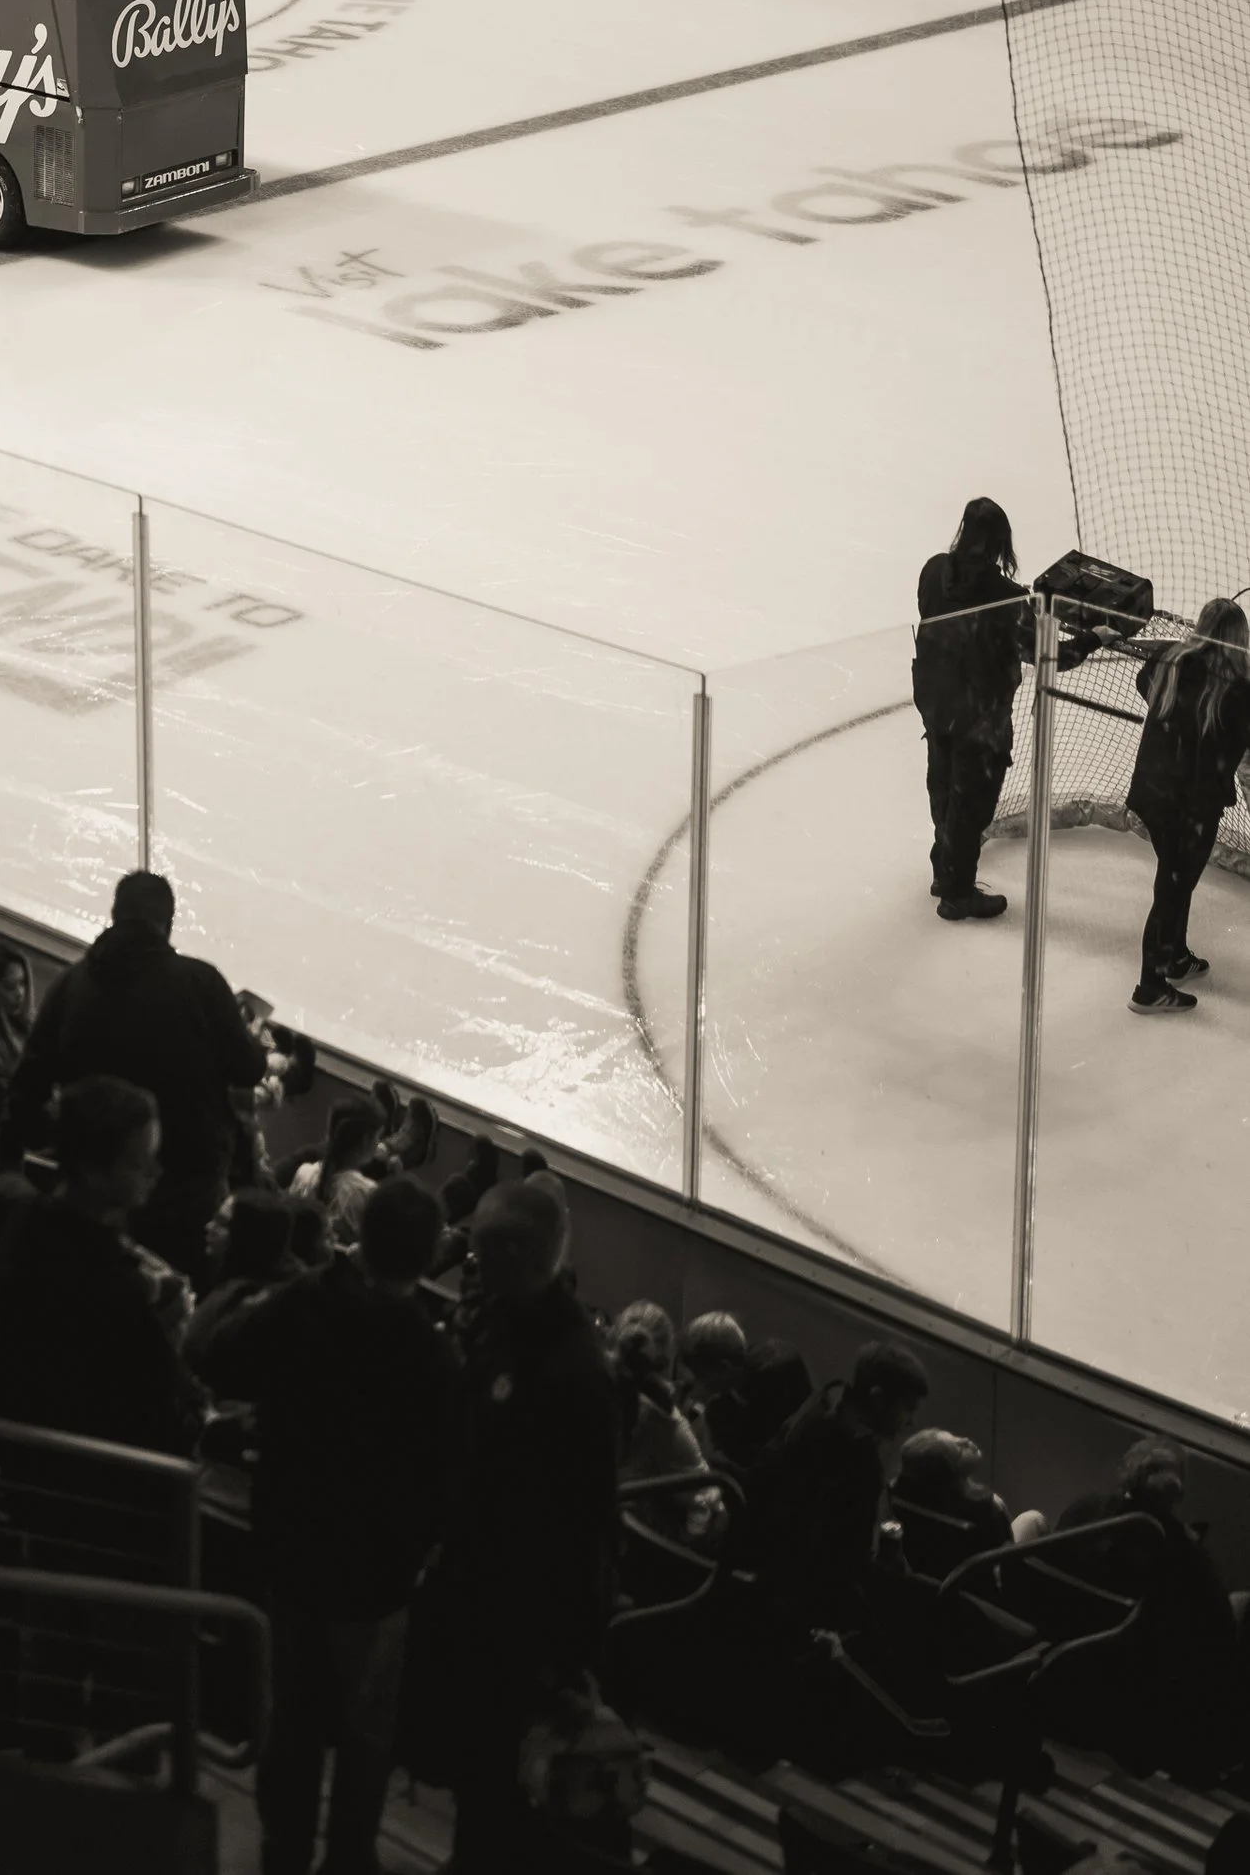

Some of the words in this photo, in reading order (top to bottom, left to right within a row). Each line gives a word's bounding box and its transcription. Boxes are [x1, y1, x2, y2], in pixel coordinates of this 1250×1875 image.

[144, 160, 210, 189] ZAMBONI
[285, 240, 727, 351] lake
[661, 115, 1184, 246] tahoe
[259, 246, 407, 300] Visit
[205, 589, 307, 631] TO
